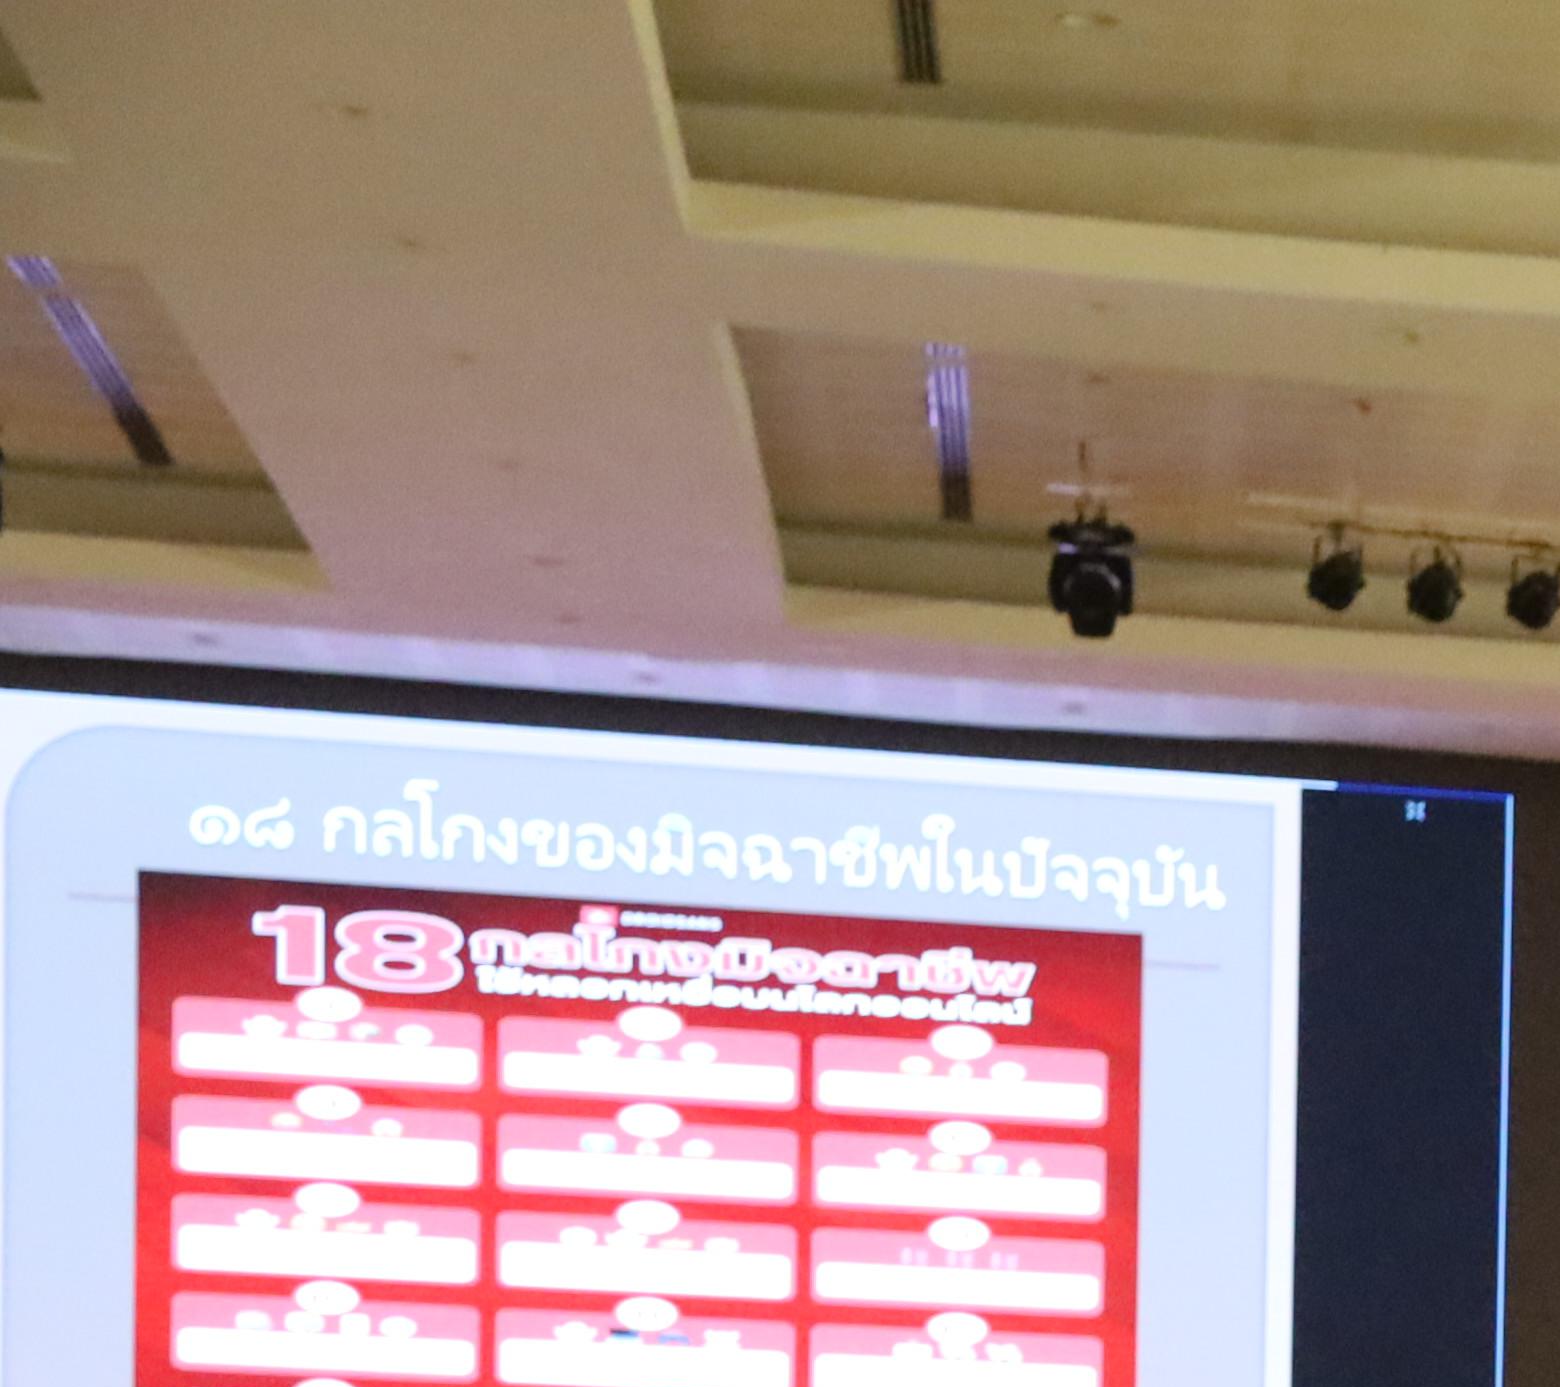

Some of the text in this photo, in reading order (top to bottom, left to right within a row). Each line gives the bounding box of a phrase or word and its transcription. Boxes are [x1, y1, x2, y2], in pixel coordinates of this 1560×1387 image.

[322, 780, 1226, 927] กลโกงของมิจฉาชีพในปัจจุบัน
[251, 905, 464, 994] 18
